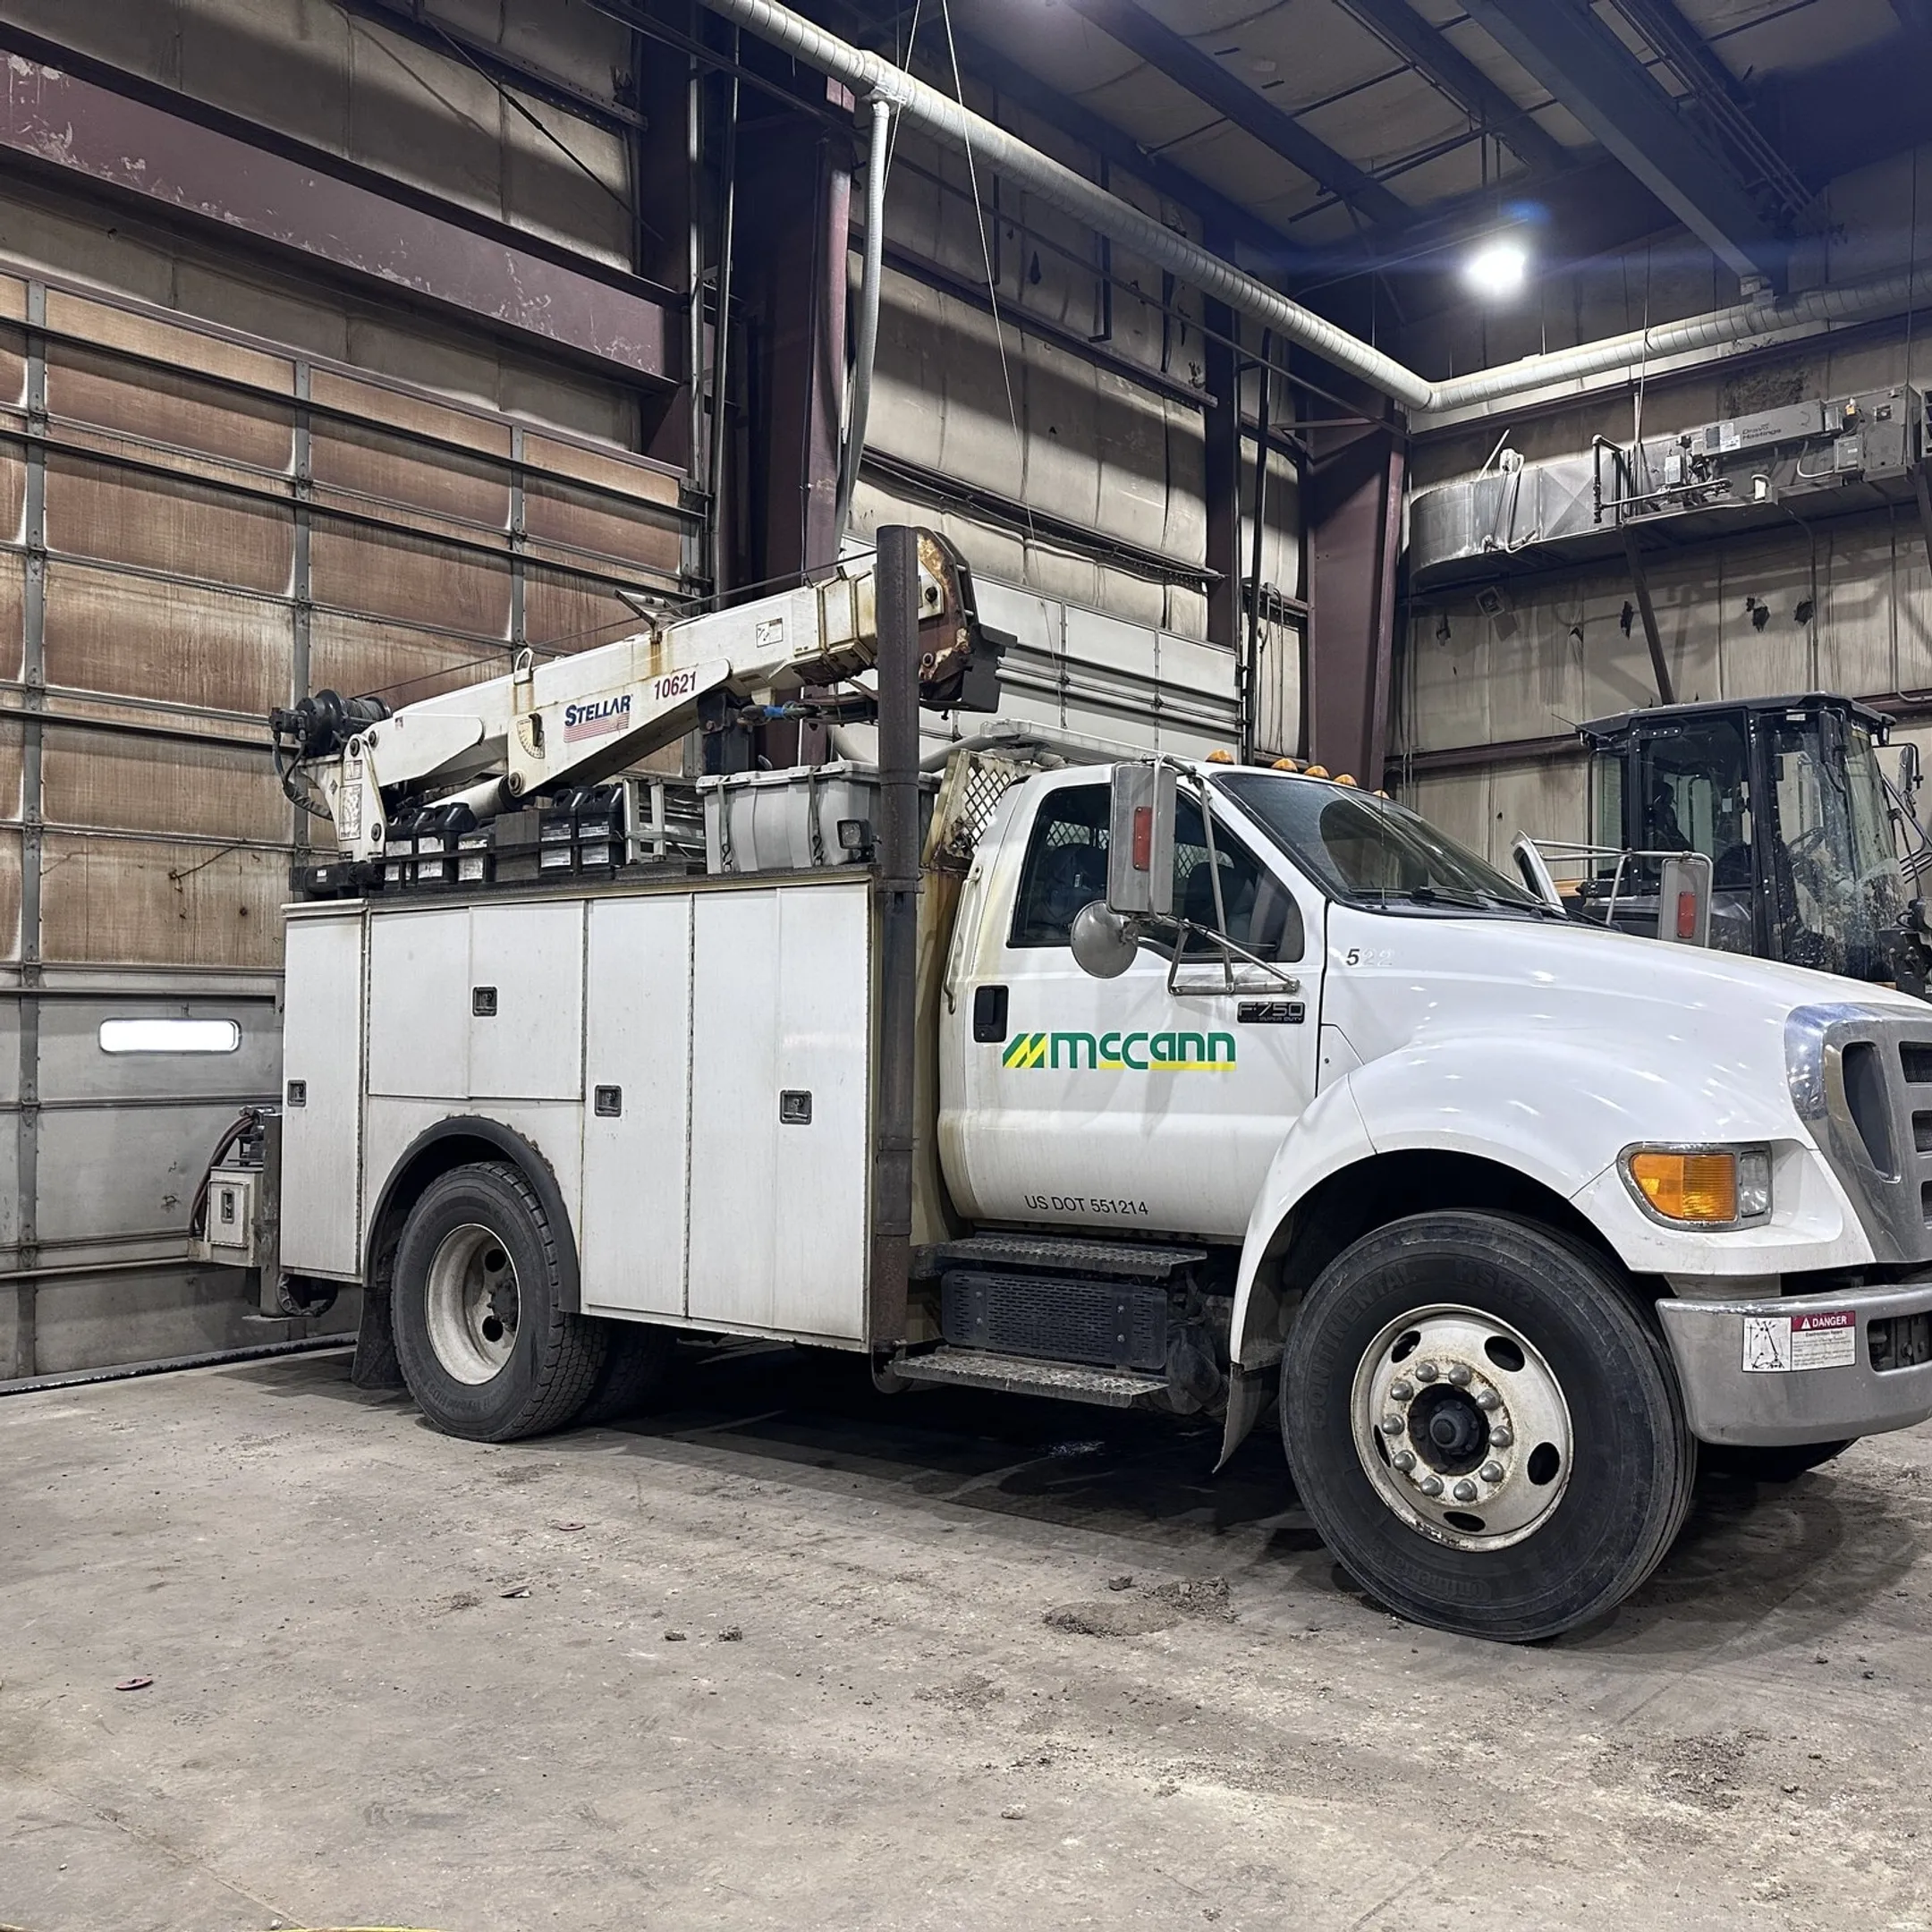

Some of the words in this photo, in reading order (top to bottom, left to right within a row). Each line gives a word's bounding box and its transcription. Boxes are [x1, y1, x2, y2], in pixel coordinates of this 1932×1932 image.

[1742, 428, 1782, 441] Hastings
[654, 671, 697, 700] 10621
[564, 694, 631, 727] STELLAR
[1024, 1195, 1049, 1210] US
[1051, 1196, 1085, 1212] DOT
[1089, 1199, 1149, 1216] 551214
[1812, 1315, 1848, 1328] DANGER
